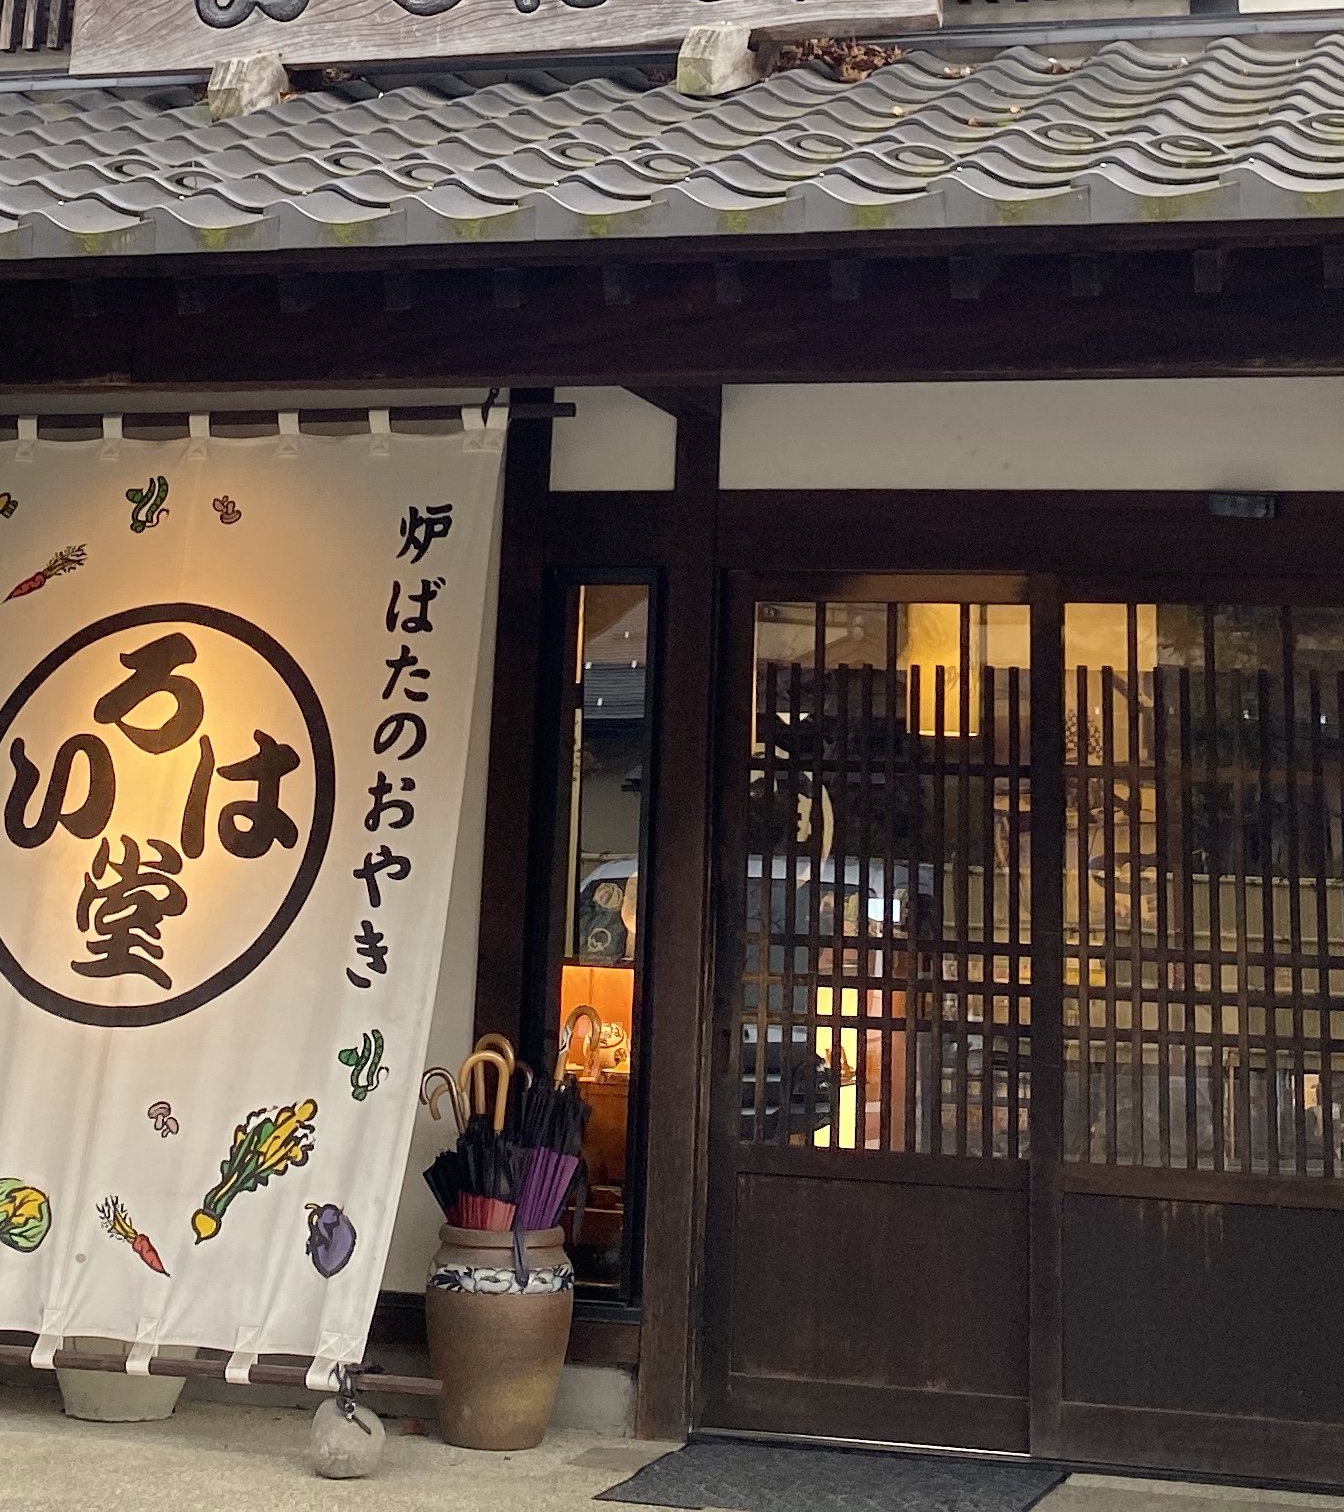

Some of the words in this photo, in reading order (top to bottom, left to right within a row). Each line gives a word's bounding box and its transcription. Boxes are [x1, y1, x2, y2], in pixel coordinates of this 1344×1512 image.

[346, 503, 453, 989] 炉ばたのおやき
